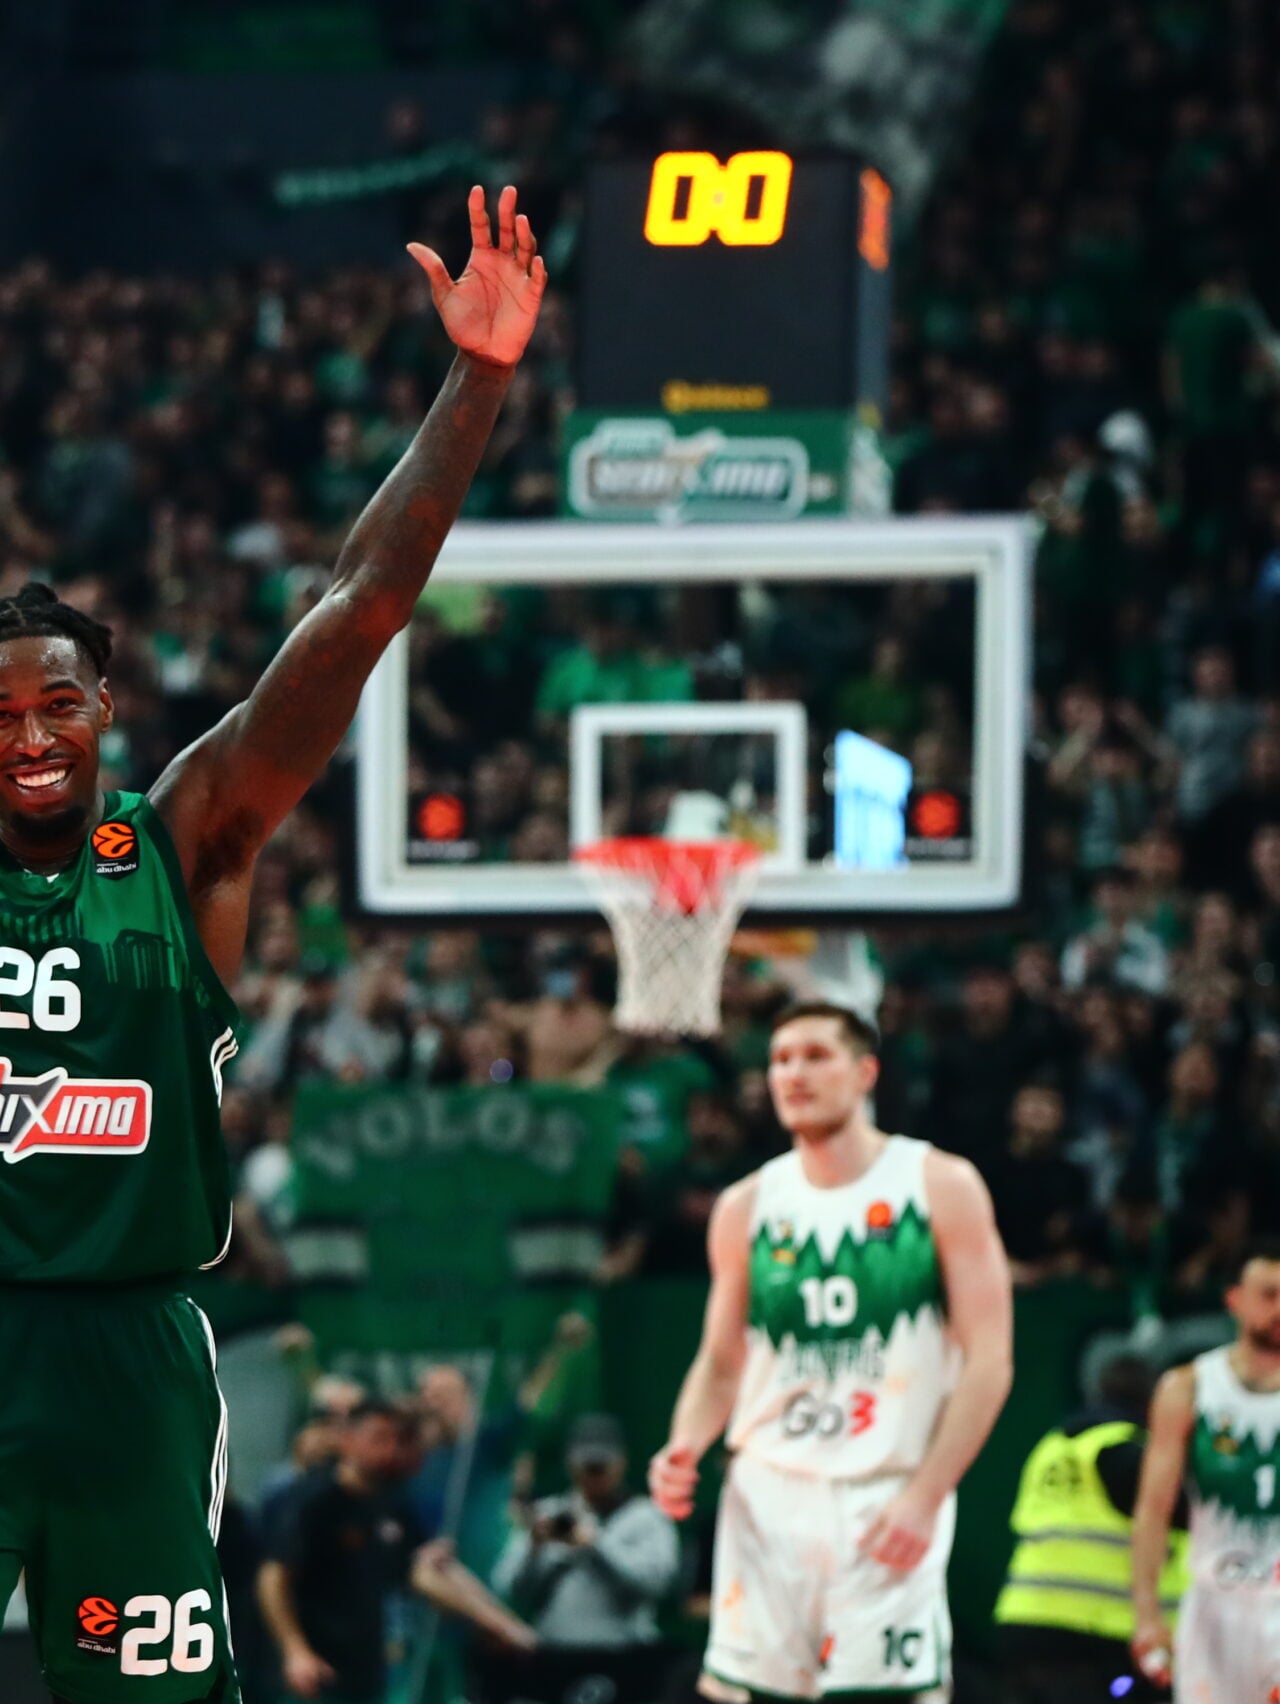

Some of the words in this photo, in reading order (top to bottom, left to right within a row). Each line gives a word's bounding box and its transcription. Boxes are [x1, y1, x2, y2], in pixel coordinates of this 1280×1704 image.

[644, 151, 793, 246] 00
[798, 1274, 858, 1328] 10
[781, 1391, 877, 1440] Go3
[120, 1589, 214, 1676] 26
